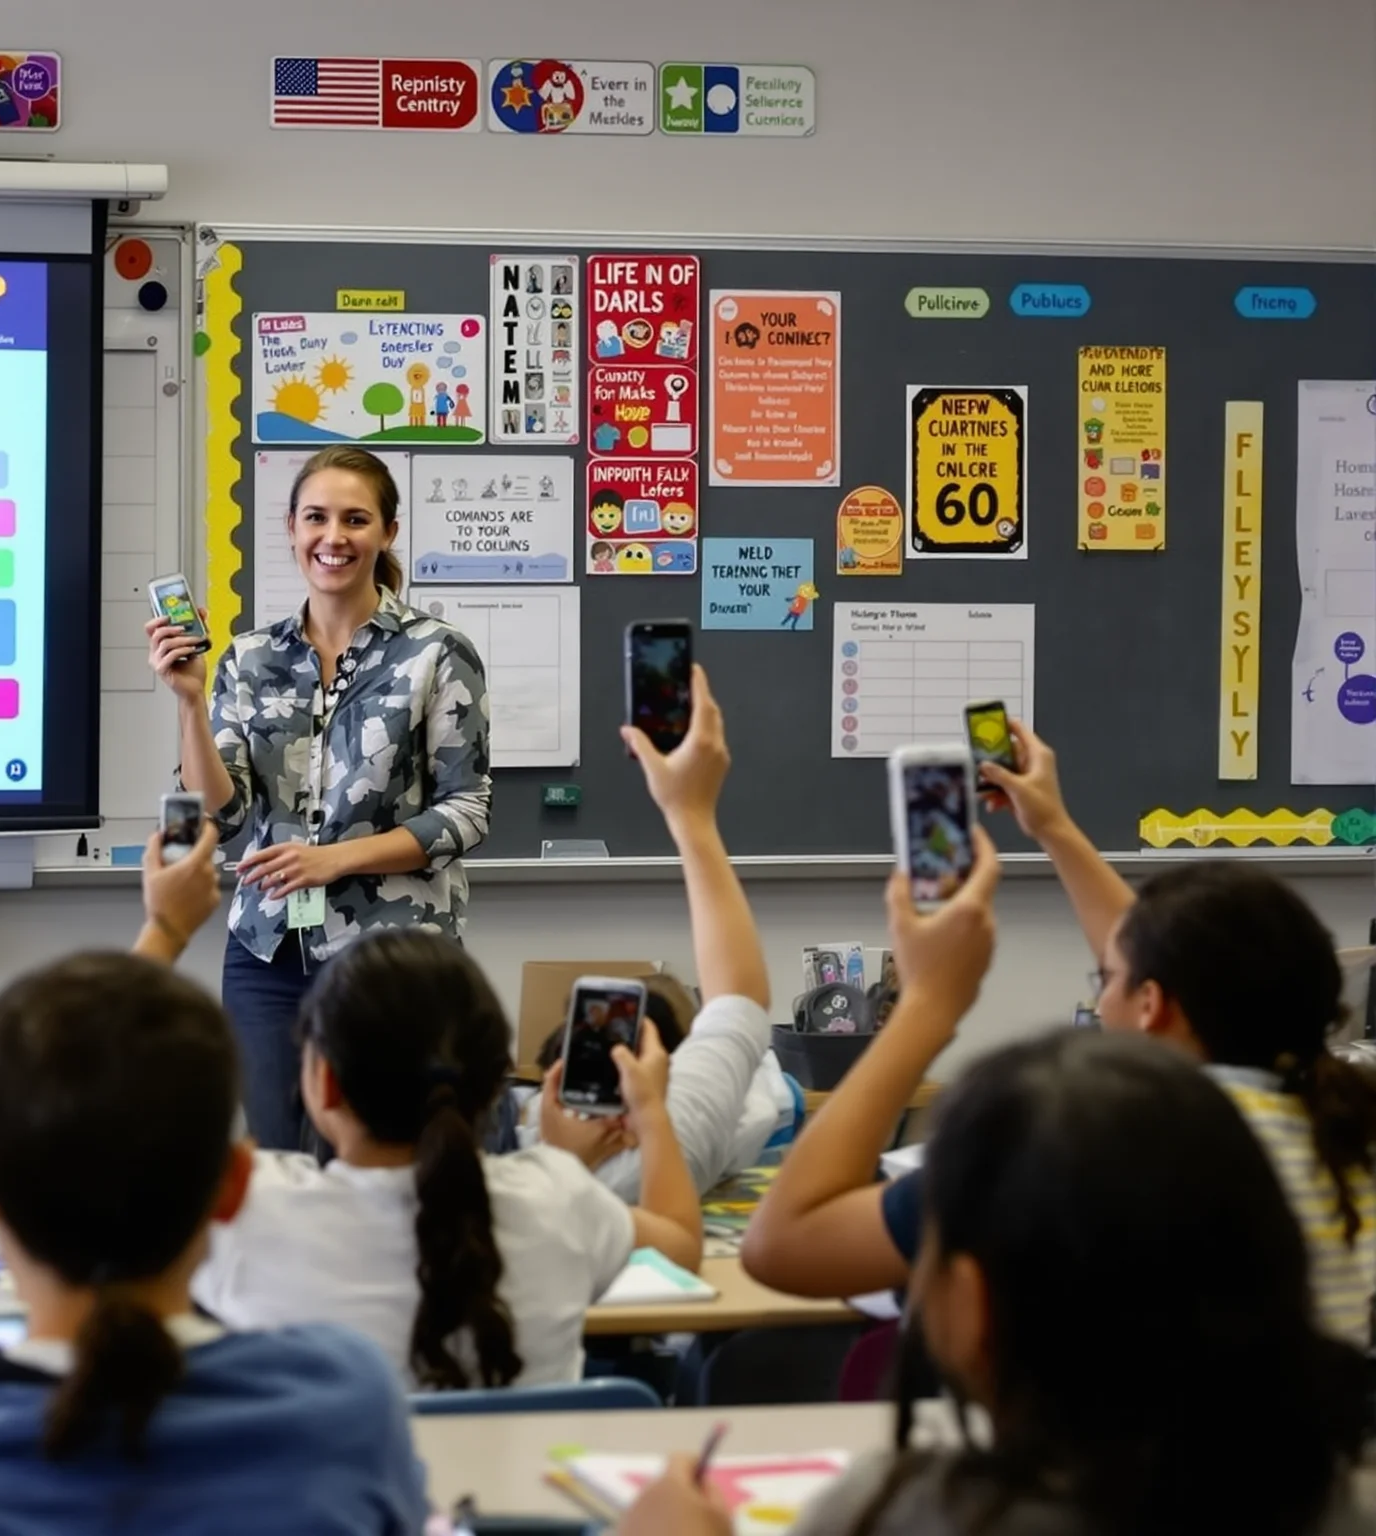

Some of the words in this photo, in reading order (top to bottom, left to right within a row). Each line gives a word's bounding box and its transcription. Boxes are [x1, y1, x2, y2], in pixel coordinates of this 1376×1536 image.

[391, 73, 466, 96] Repnisty
[634, 76, 647, 91] in
[603, 94, 626, 108] the
[594, 261, 639, 285] LIFE
[668, 263, 696, 286] OF
[594, 288, 665, 313] DARLS
[760, 311, 798, 328] YOUR
[1089, 363, 1115, 377] AND
[941, 443, 956, 457] IN
[965, 443, 989, 457] THE
[935, 482, 1000, 527] 60
[510, 509, 534, 523] ARE
[456, 524, 473, 537] TO
[738, 546, 774, 561] NELD
[770, 564, 802, 579] THET
[738, 583, 771, 597] YOUR
